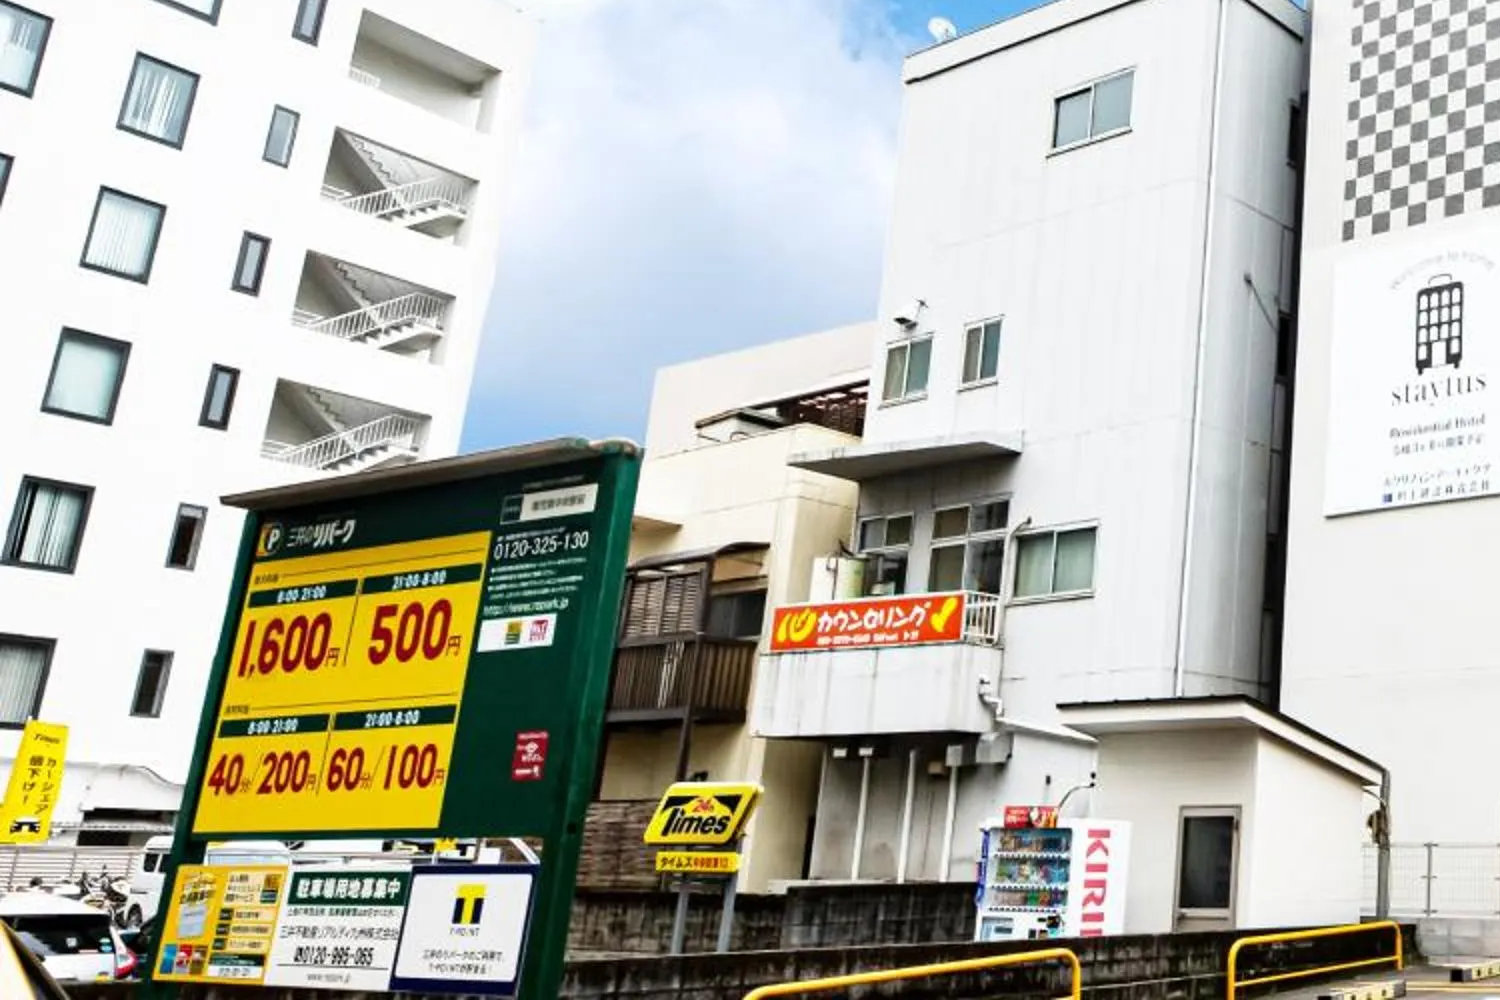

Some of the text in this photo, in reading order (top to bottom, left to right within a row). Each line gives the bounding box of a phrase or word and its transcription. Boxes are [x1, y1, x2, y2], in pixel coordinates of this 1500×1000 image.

[493, 530, 590, 560] 0120-325-130
[660, 807, 731, 837] Times
[1080, 828, 1111, 937] KIRI
